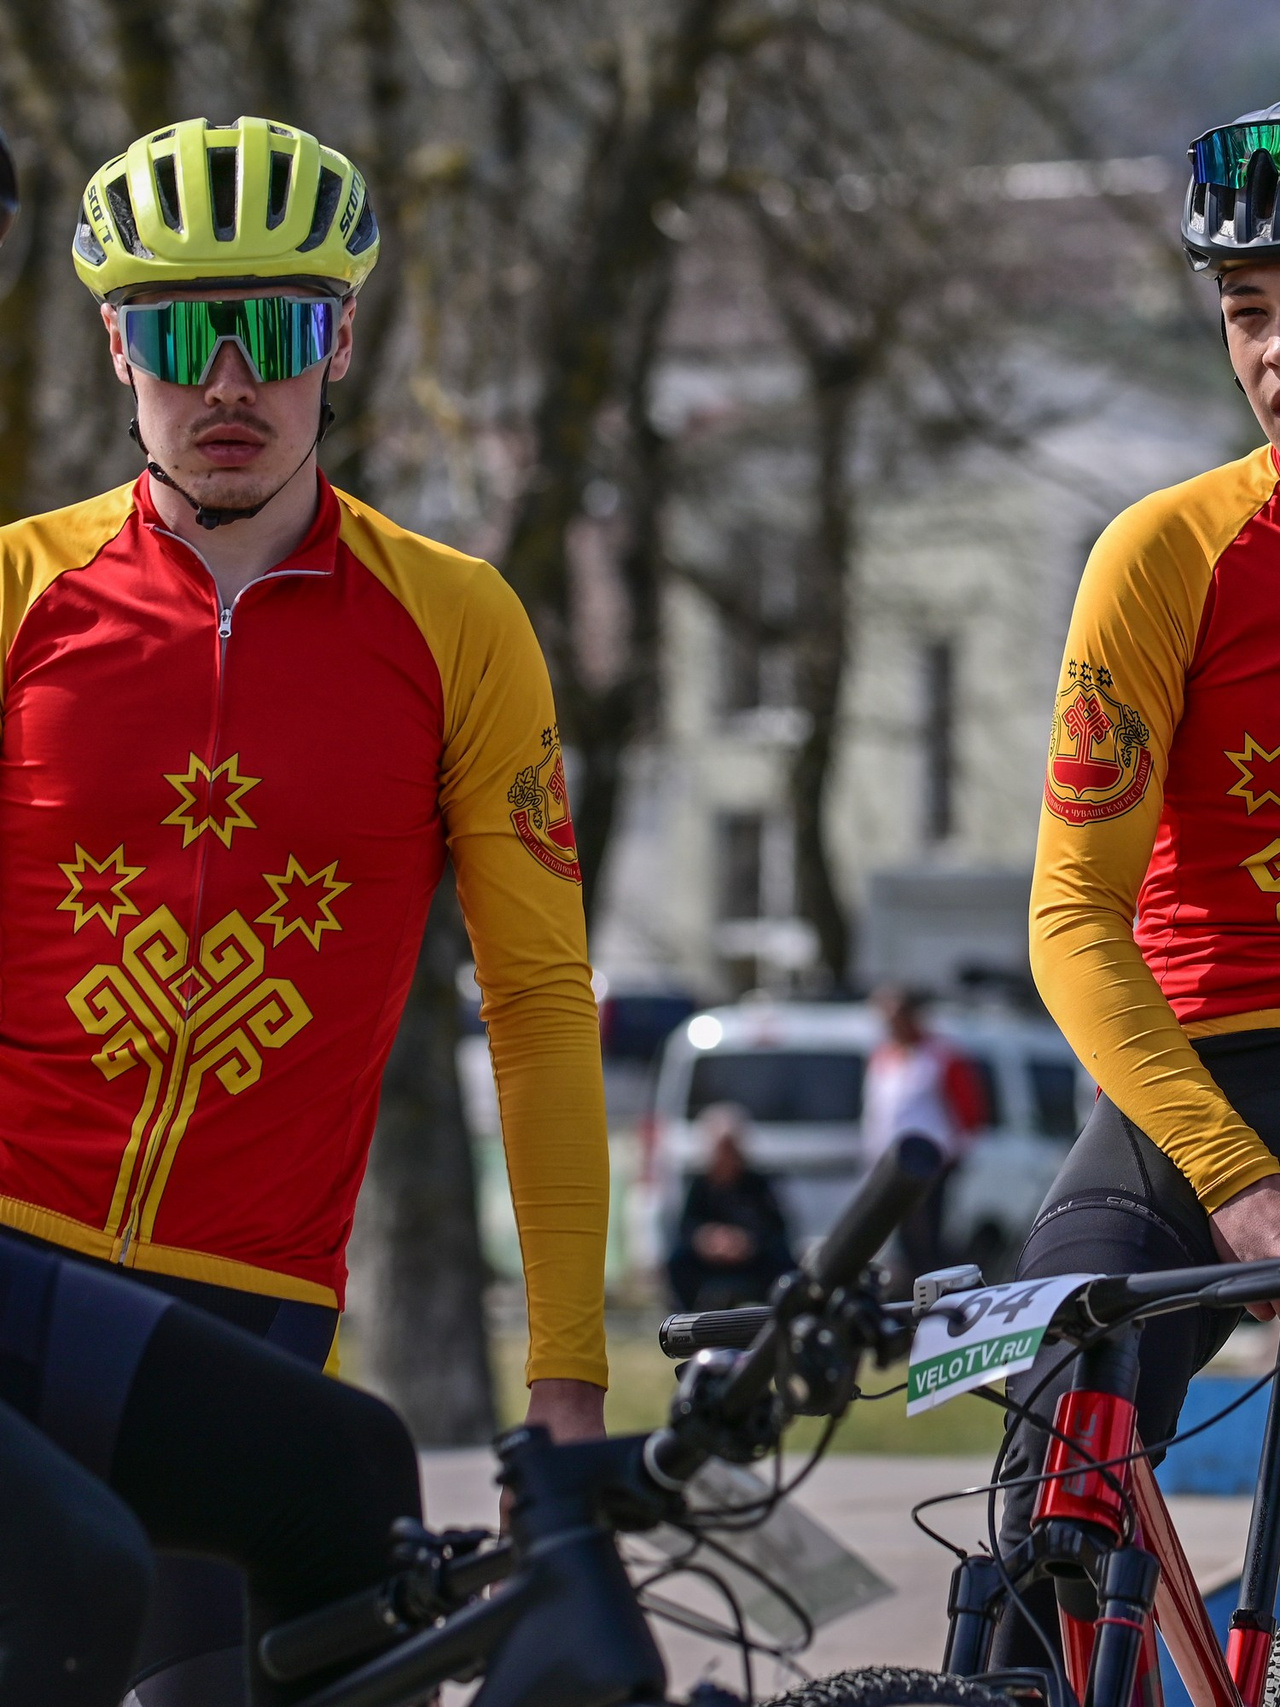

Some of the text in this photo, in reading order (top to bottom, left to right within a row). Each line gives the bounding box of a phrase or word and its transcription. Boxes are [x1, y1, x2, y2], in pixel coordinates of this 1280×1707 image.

[87, 184, 114, 244] SCOT
[339, 171, 361, 240] SCOTT
[1071, 802, 1125, 818] ЧУВАШСКАЯ
[947, 1279, 1055, 1337] 64
[915, 1336, 1032, 1394] VELOTV.RU
